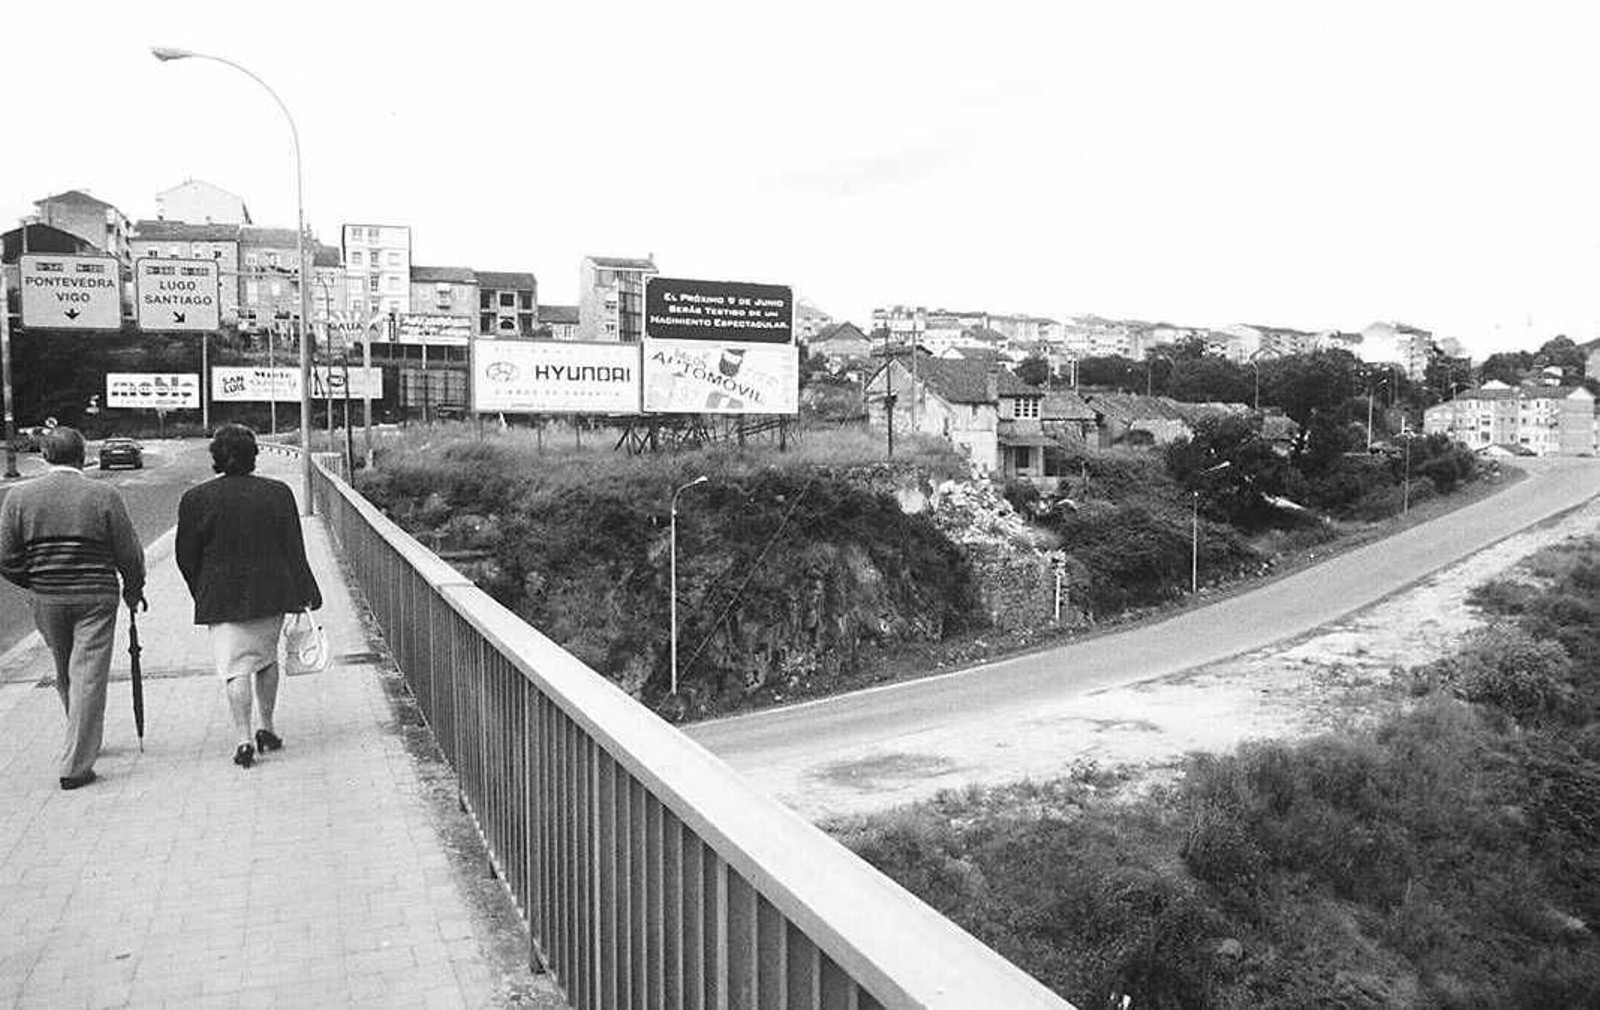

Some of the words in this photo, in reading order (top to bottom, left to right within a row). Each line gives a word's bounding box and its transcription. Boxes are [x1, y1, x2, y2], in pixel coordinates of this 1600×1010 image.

[25, 276, 115, 288] PONTEVEDRA
[160, 280, 196, 291] LUGO
[56, 292, 90, 303] VIGO
[144, 294, 212, 305] SANTIAGO
[738, 298, 751, 306] DE
[754, 299, 784, 308] JUNIO
[704, 307, 746, 317] TESTIGO
[748, 309, 761, 317] DE
[650, 316, 712, 326] NACIMIENTO
[535, 364, 631, 383] HYUNDAI
[222, 374, 245, 385] SAN
[223, 383, 246, 394] LUIS
